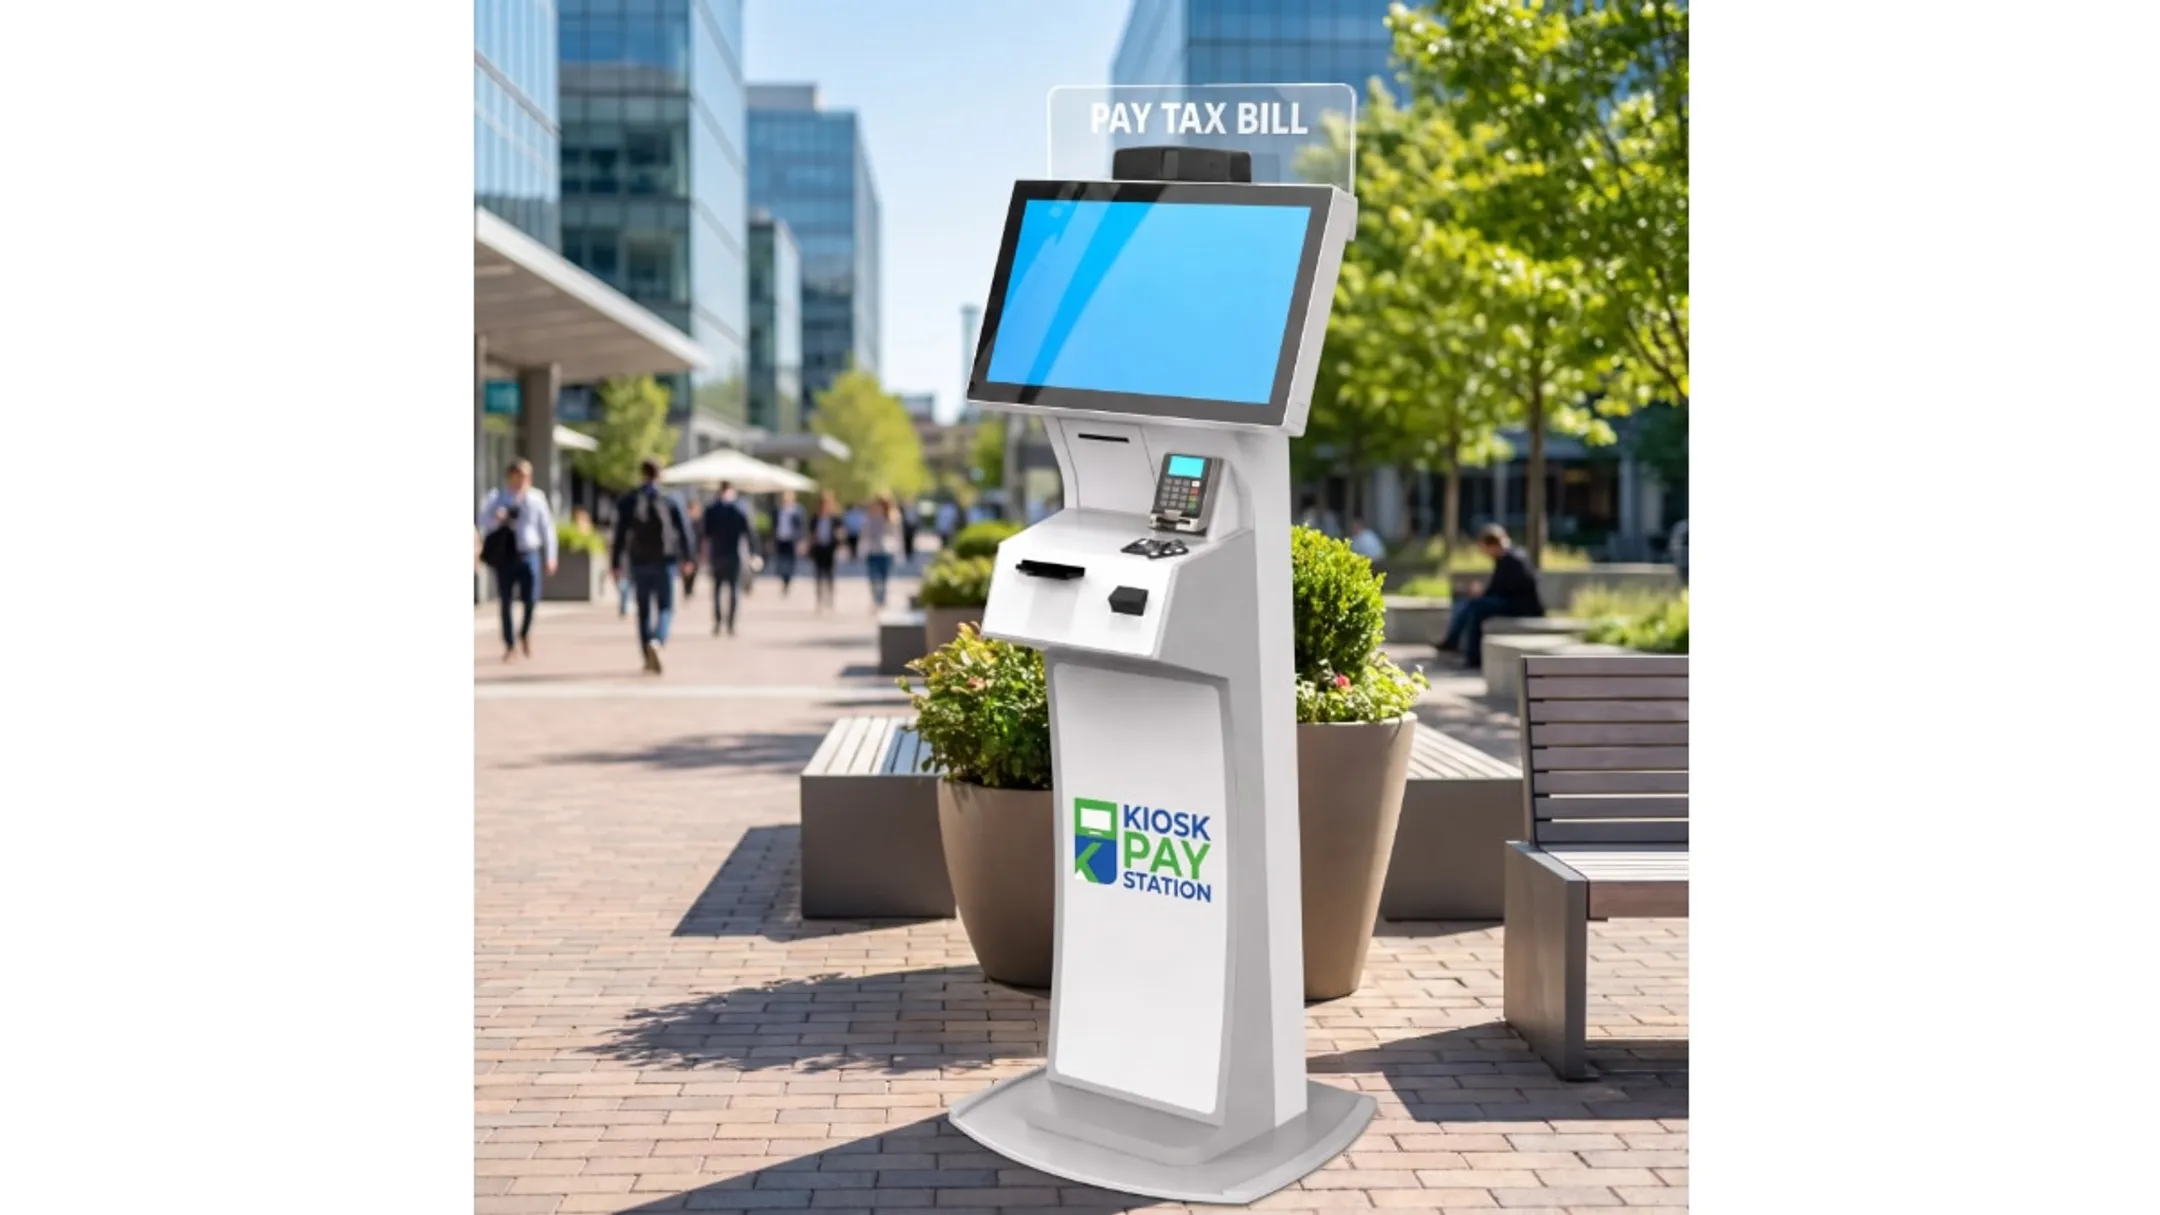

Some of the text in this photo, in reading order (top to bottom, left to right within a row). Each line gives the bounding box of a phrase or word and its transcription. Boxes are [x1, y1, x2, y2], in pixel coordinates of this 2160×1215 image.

[1090, 102, 1308, 135] PAY TAX BILL
[1123, 804, 1211, 841] KIOSK
[1123, 830, 1211, 880] PAY
[1123, 871, 1211, 902] STATION
